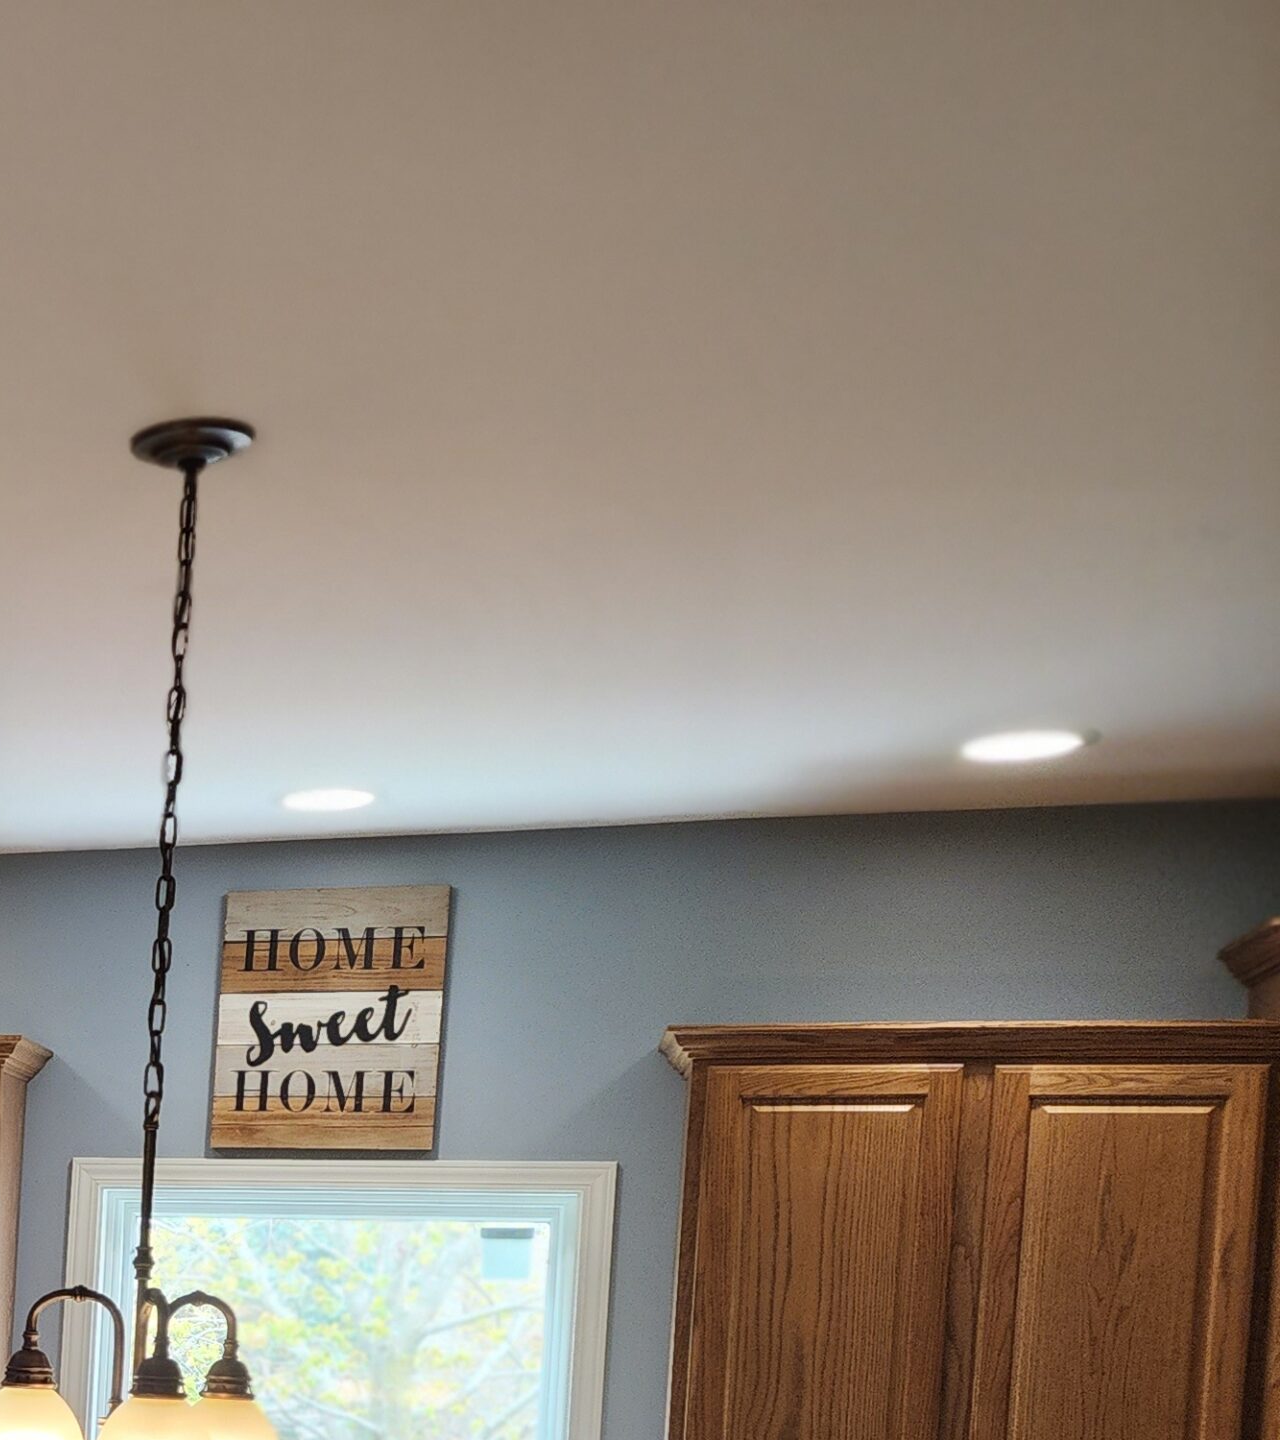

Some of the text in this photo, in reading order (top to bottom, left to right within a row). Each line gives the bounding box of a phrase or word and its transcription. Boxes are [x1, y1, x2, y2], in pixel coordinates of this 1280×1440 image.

[237, 925, 426, 972] HOME
[246, 984, 413, 1067] Sweet
[228, 1069, 416, 1114] HOME
